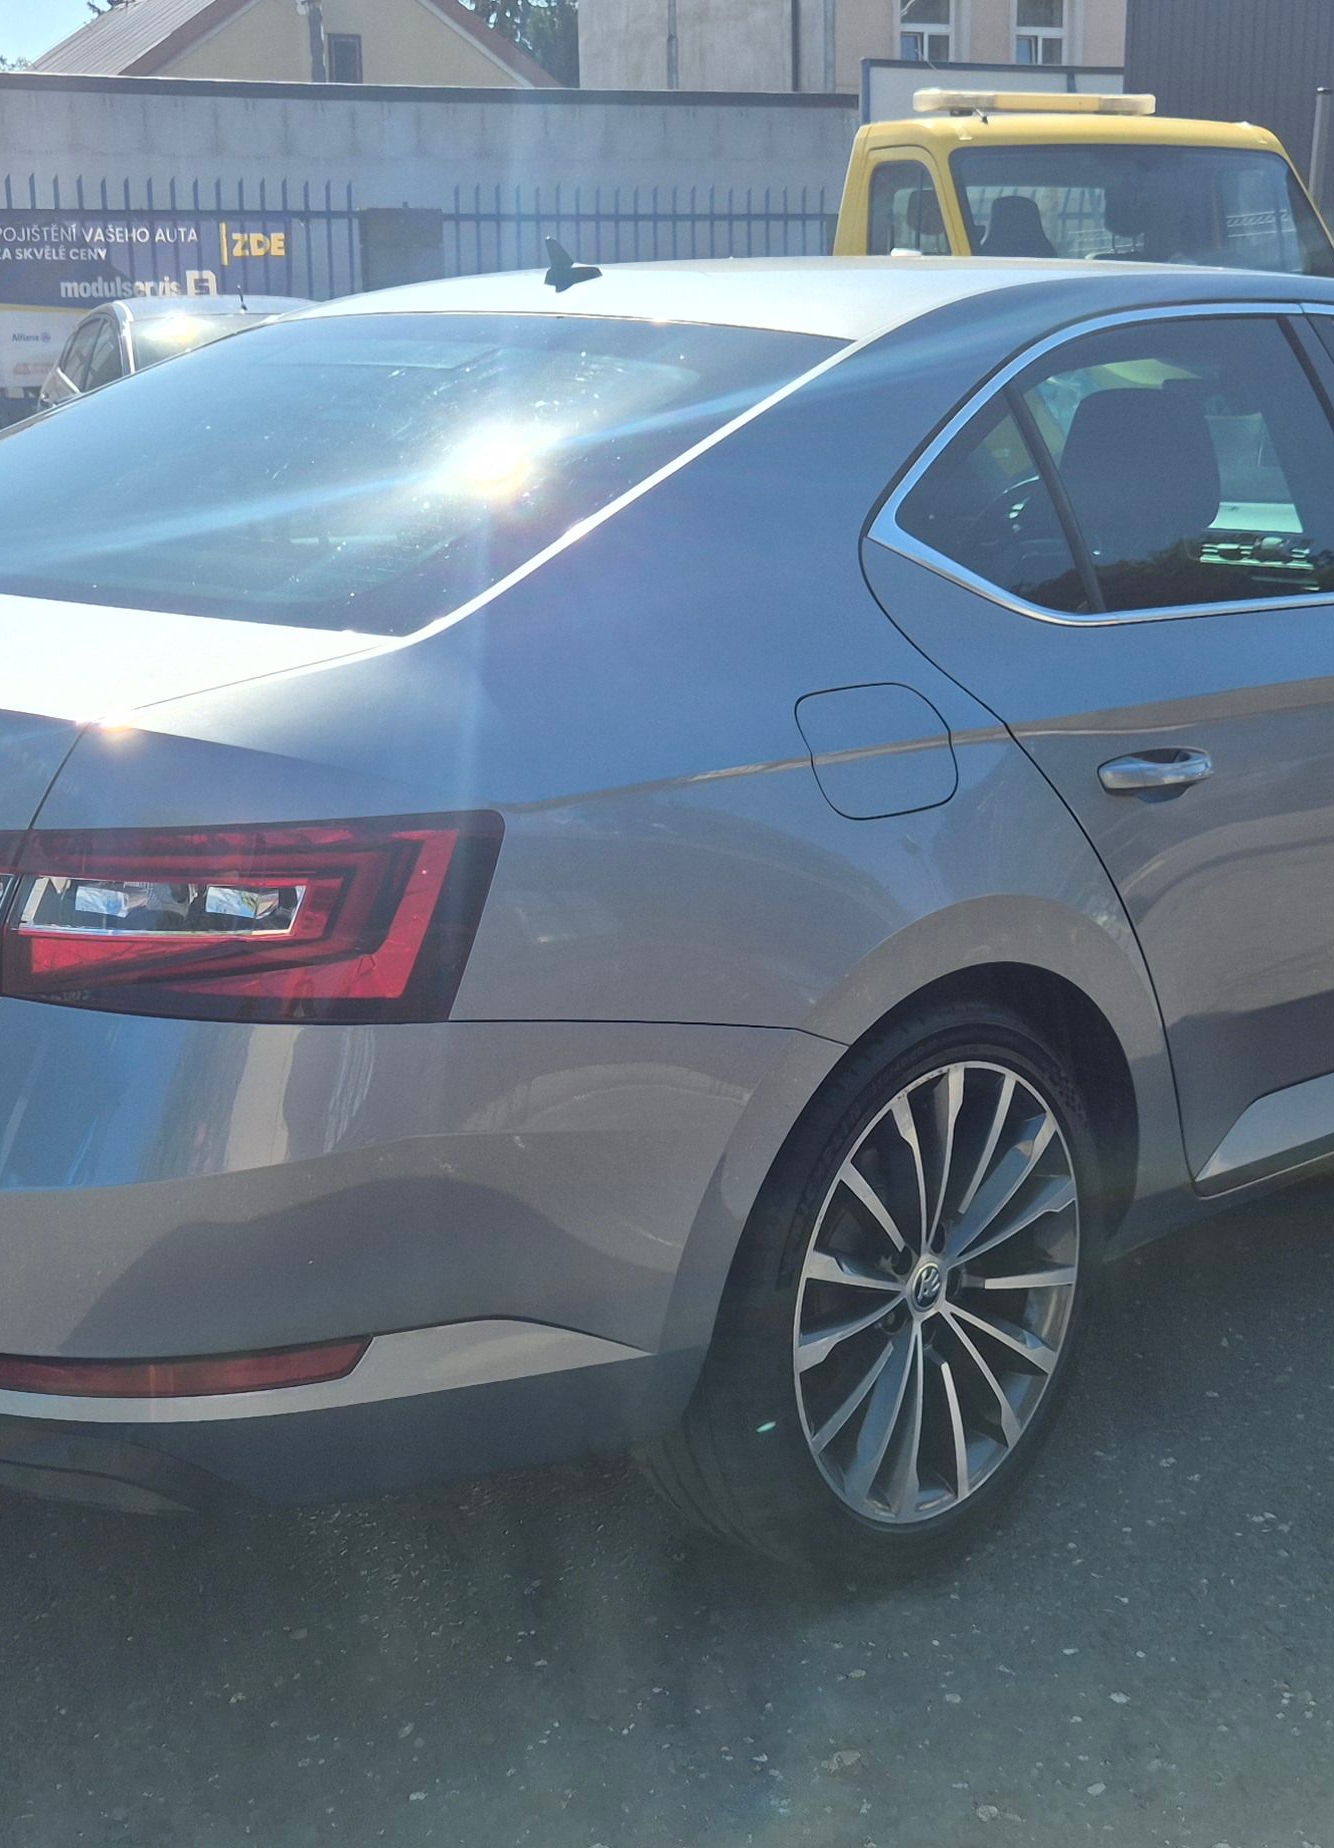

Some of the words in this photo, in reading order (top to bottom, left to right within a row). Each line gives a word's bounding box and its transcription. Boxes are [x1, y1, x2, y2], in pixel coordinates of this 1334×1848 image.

[82, 223, 149, 243] VAŠEHO
[155, 227, 198, 243] AUTA
[15, 245, 66, 260] SKVĚLÉ
[69, 248, 107, 261] CENY
[232, 232, 286, 258] ZDE
[60, 275, 181, 298] modulservis
